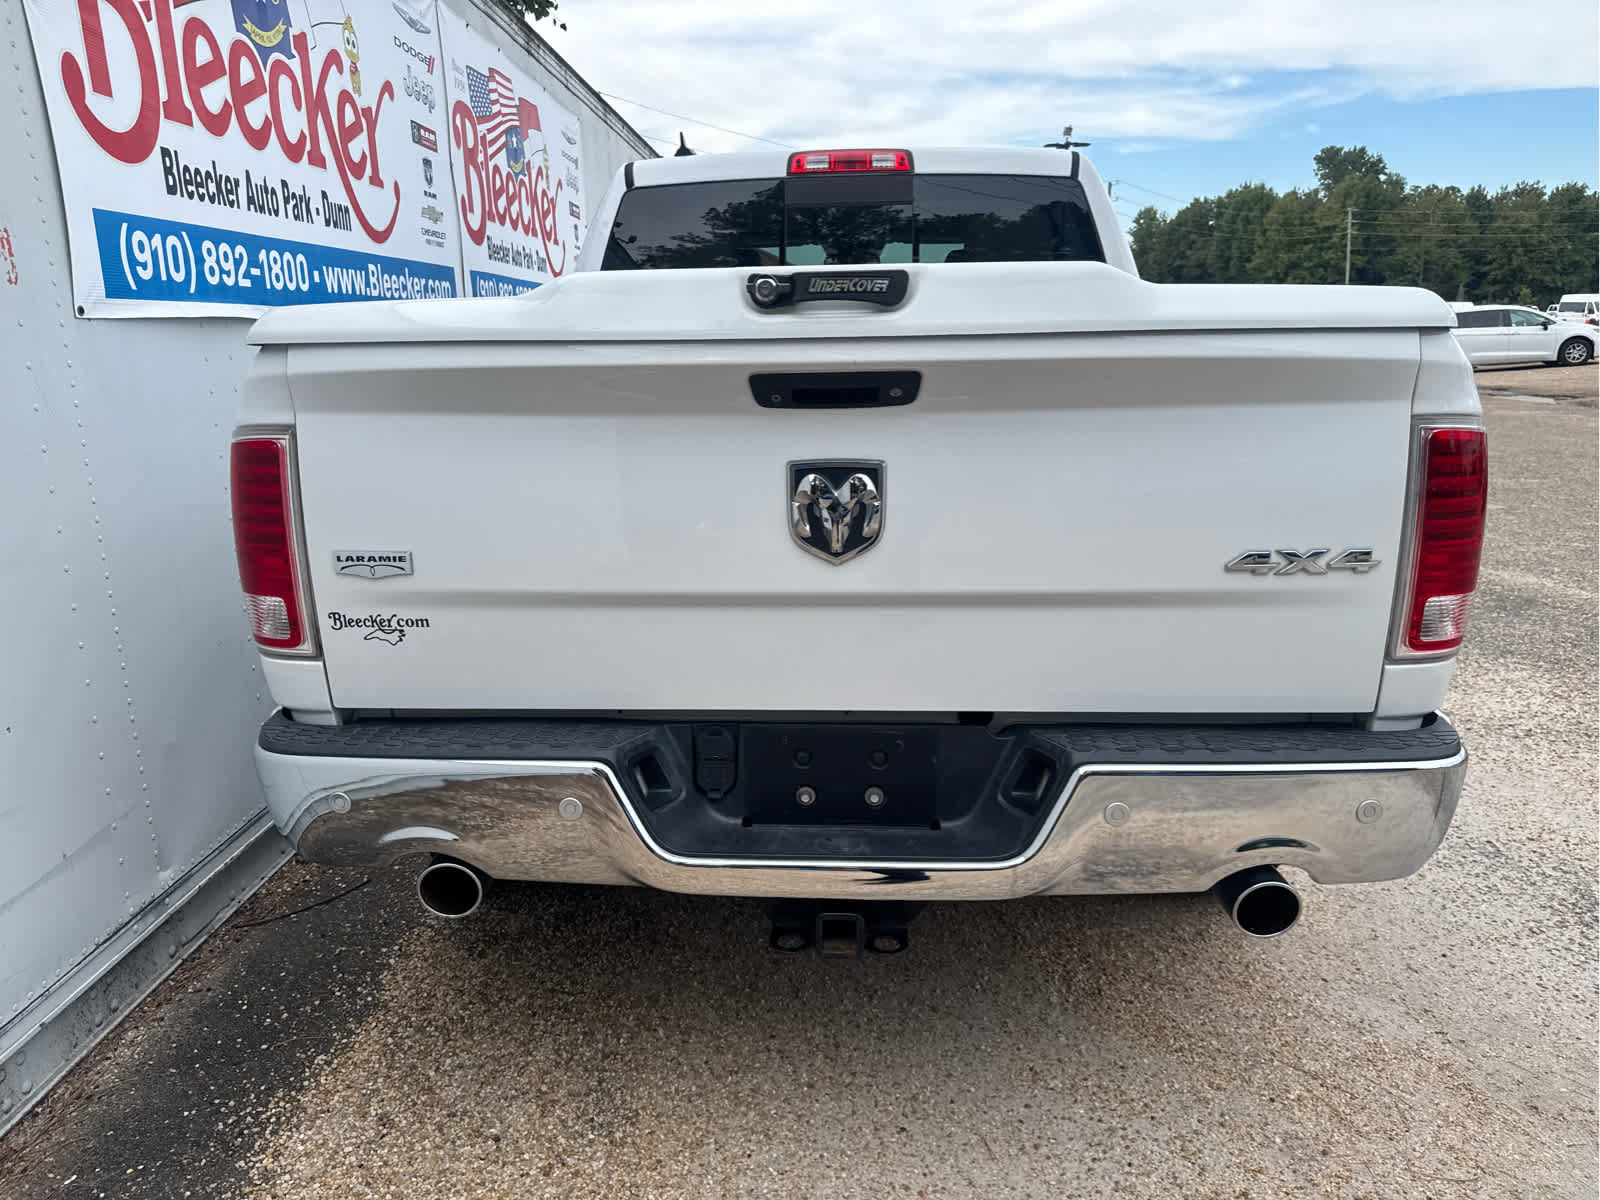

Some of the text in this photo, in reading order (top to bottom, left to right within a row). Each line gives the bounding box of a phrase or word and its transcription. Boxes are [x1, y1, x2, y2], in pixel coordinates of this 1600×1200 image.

[393, 35, 430, 67] DODGE
[403, 64, 435, 114] Jeep
[160, 146, 241, 210] Bleecker
[245, 169, 280, 218] Auto
[281, 179, 314, 225] Park
[321, 189, 352, 232] Dunn
[453, 99, 566, 278] Bleecker
[120, 222, 197, 294] (910)
[202, 239, 310, 293] 892-1800
[322, 263, 452, 299] www.Bleecker.com
[336, 555, 407, 563] LARAMIE
[1224, 549, 1382, 576] 4X4
